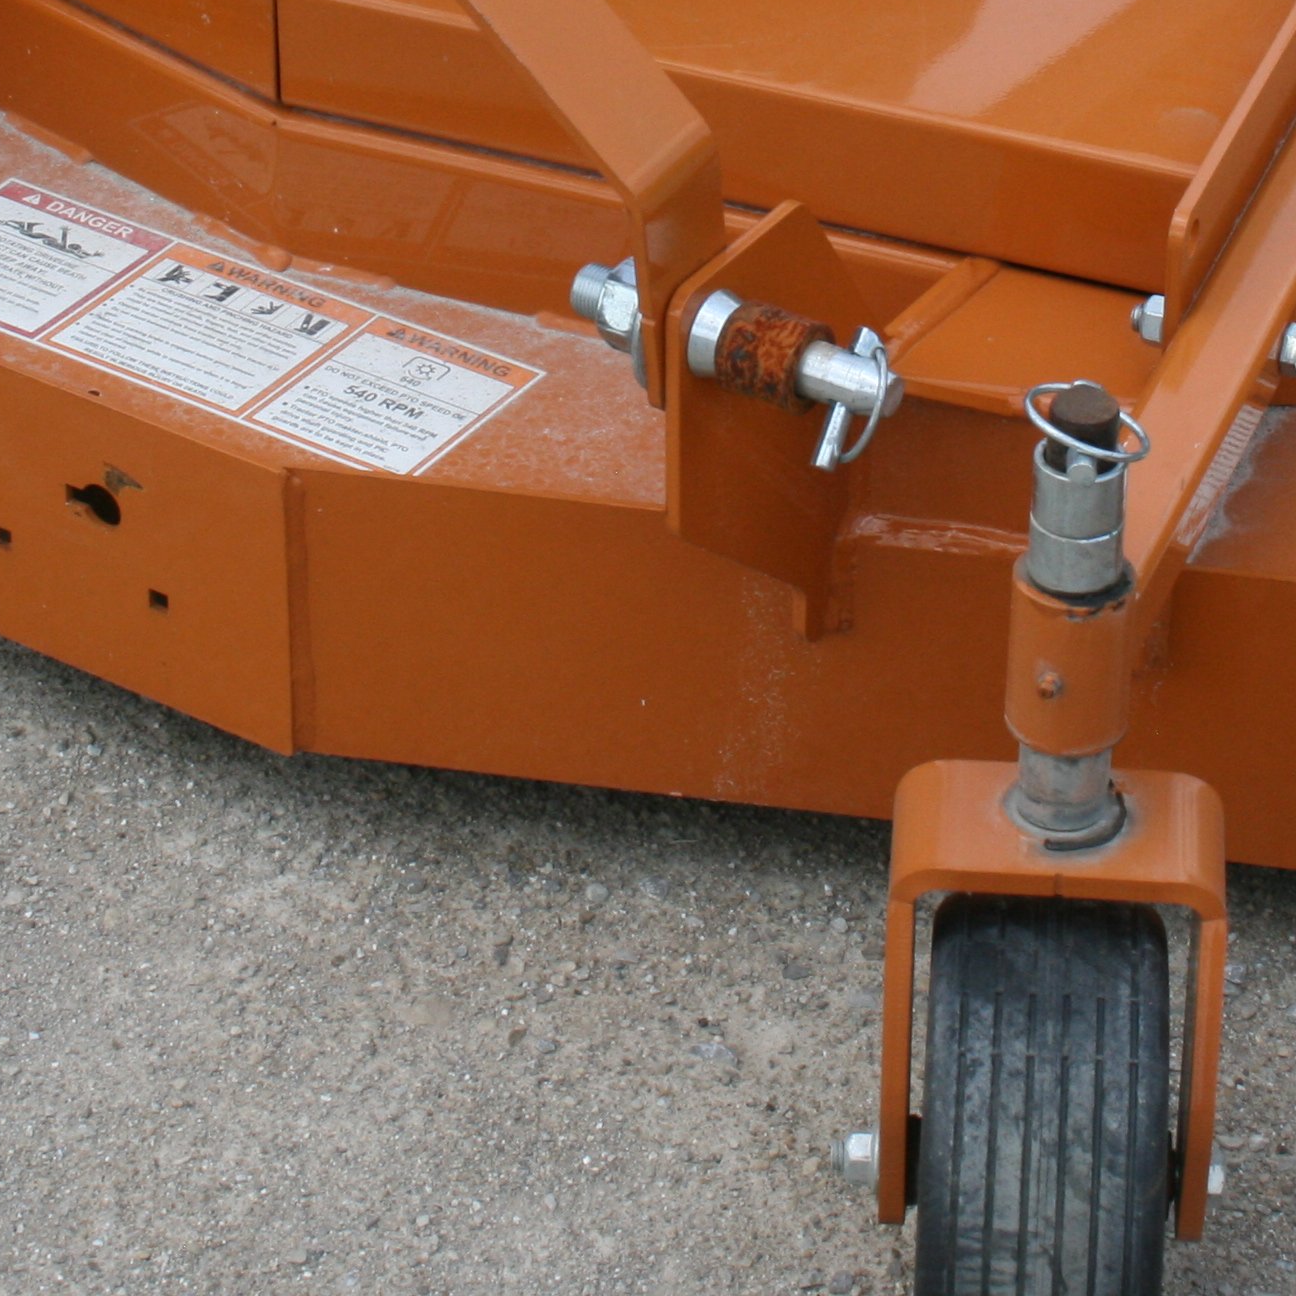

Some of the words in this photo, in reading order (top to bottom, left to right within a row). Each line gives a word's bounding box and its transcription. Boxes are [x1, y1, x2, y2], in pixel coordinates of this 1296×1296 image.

[44, 200, 135, 238] DANGER
[223, 266, 328, 309] WARNING
[159, 287, 204, 306] CRUSHING
[200, 302, 222, 312] AND
[218, 308, 260, 327] PINCHING
[257, 323, 294, 339] HAZARD
[406, 333, 513, 377] WARNING
[342, 384, 381, 403] 540
[375, 397, 425, 419] RPM
